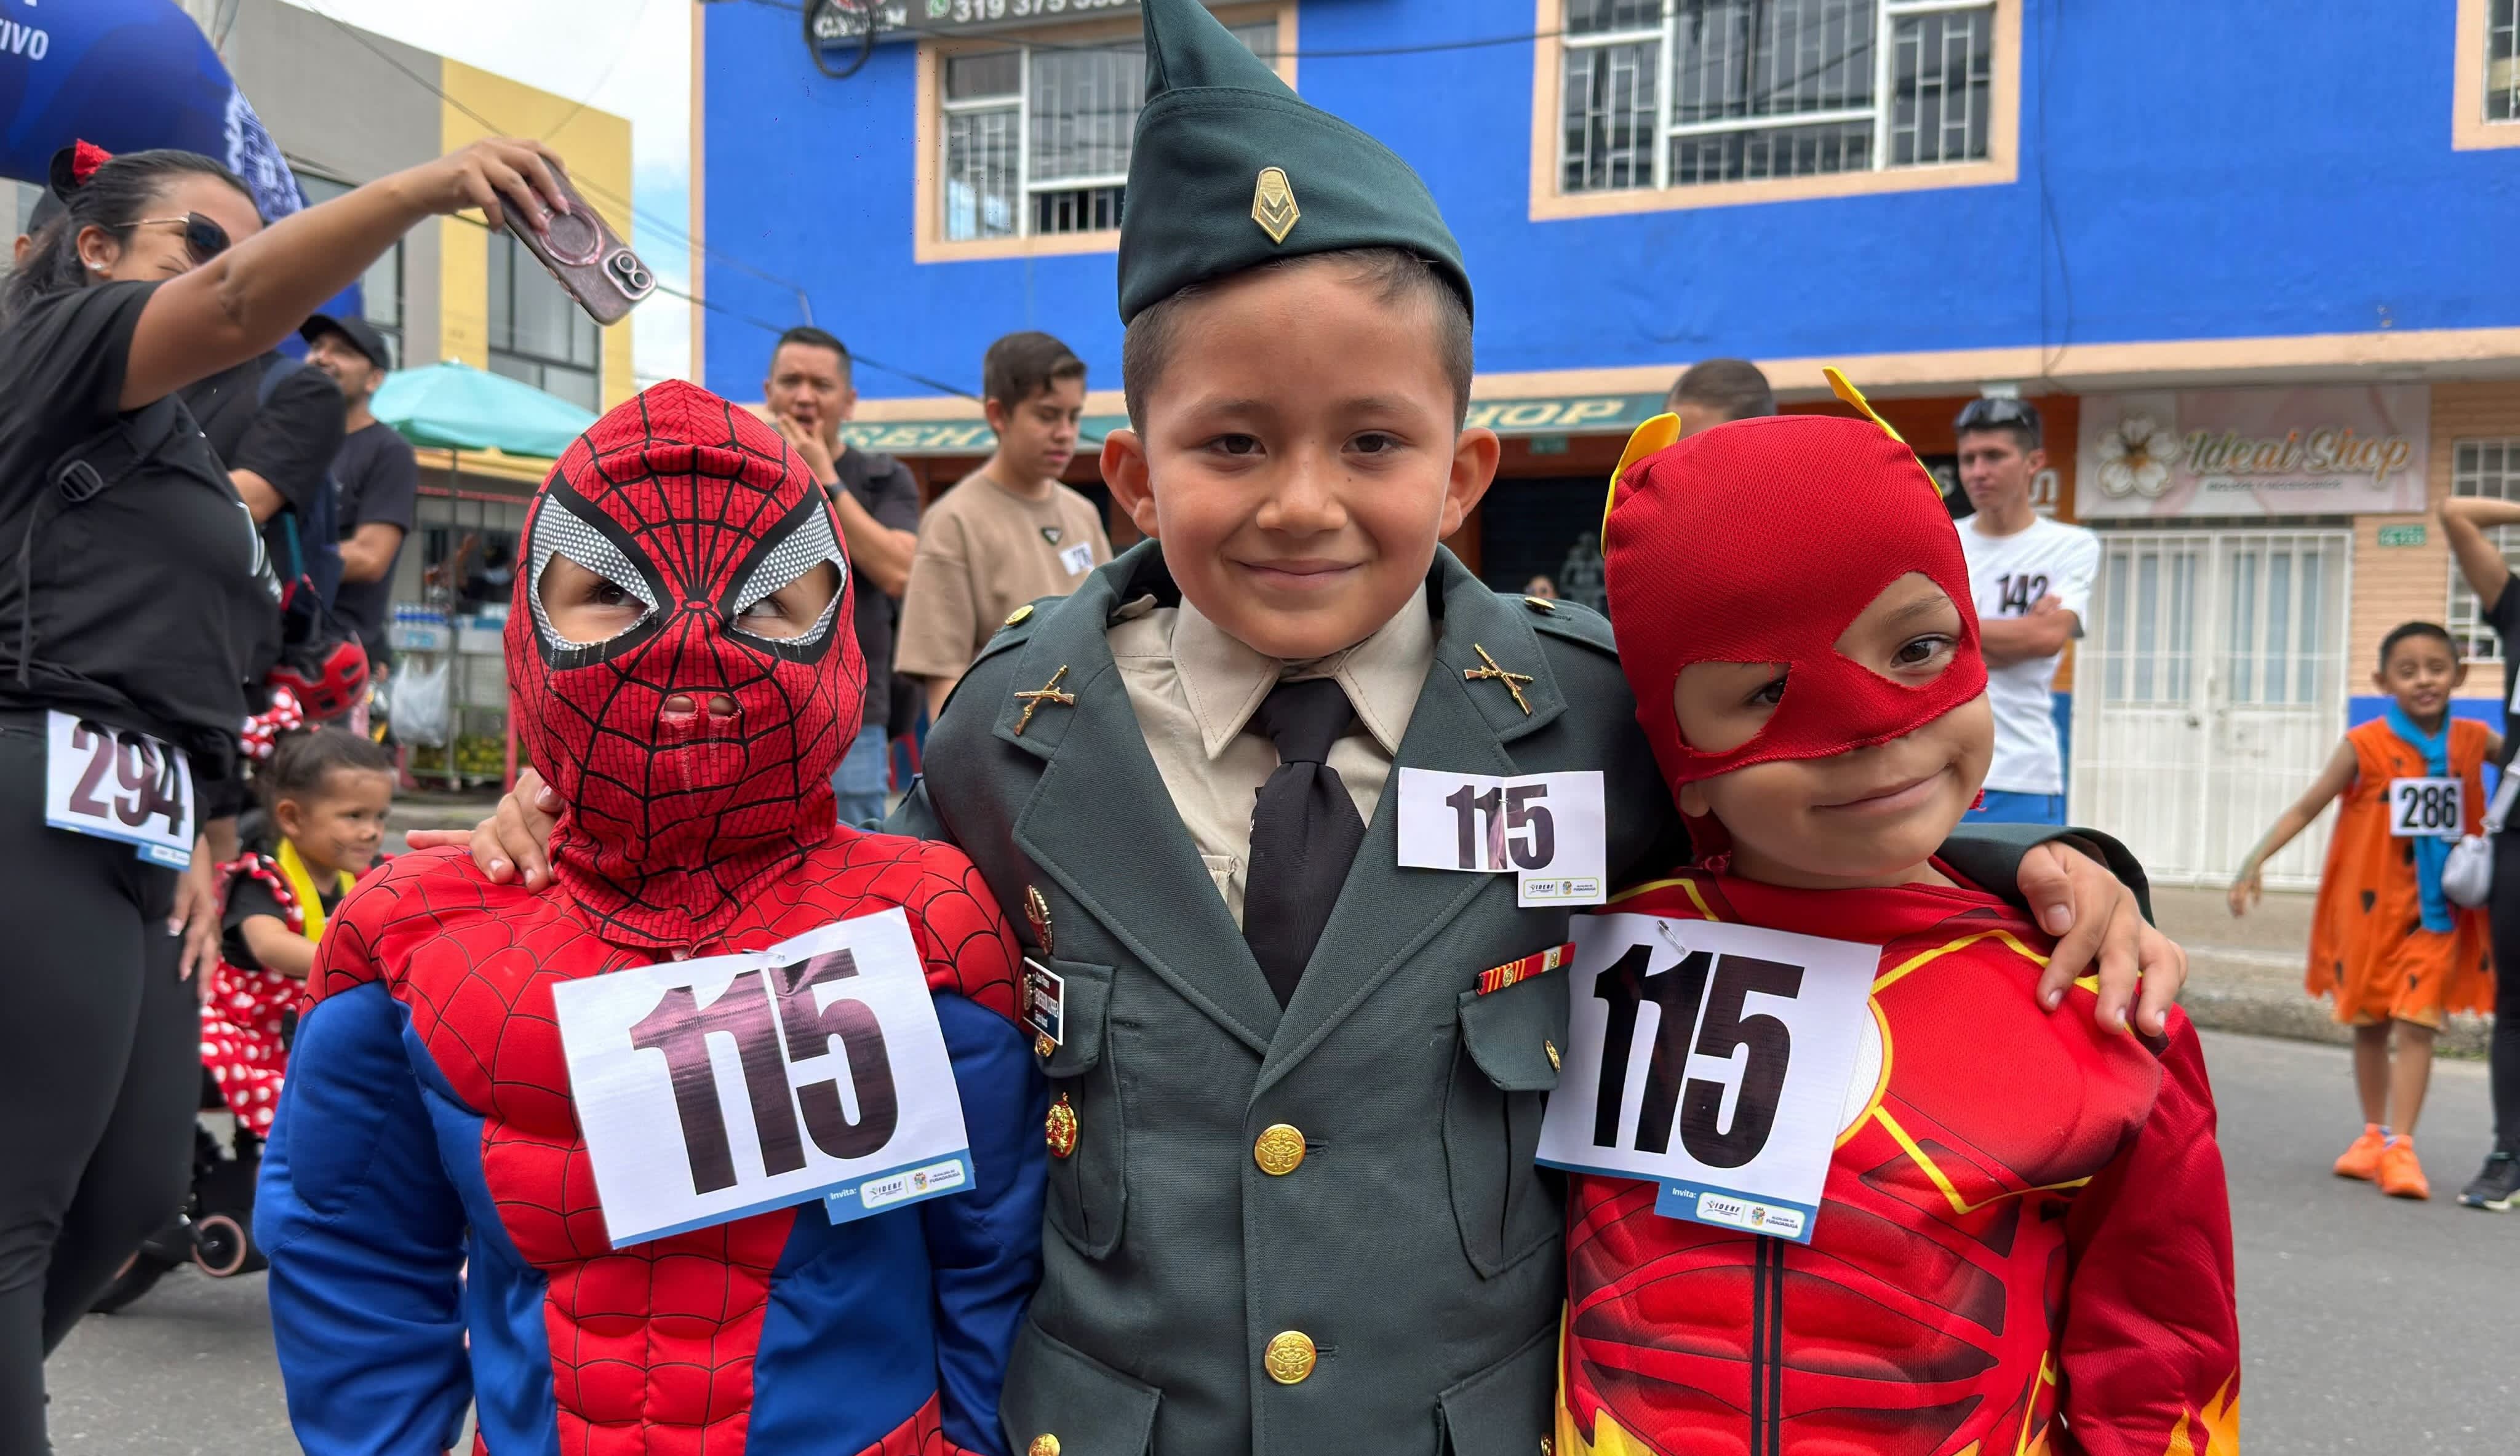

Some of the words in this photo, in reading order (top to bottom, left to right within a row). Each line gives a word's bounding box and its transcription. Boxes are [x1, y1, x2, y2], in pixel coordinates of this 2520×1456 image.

[0, 18, 49, 61] IVO
[1465, 400, 1625, 427] HOP
[2185, 429, 2303, 474] Ideal
[2304, 426, 2411, 488] Shop
[1996, 573, 2048, 615] 142
[69, 720, 186, 837] 294
[1446, 784, 1555, 870] 115
[2401, 786, 2457, 828] 286
[629, 948, 898, 1195] 115
[1593, 944, 1805, 1169] 115
[830, 1187, 858, 1200] Invita:
[1672, 1187, 1697, 1199] Invita:
